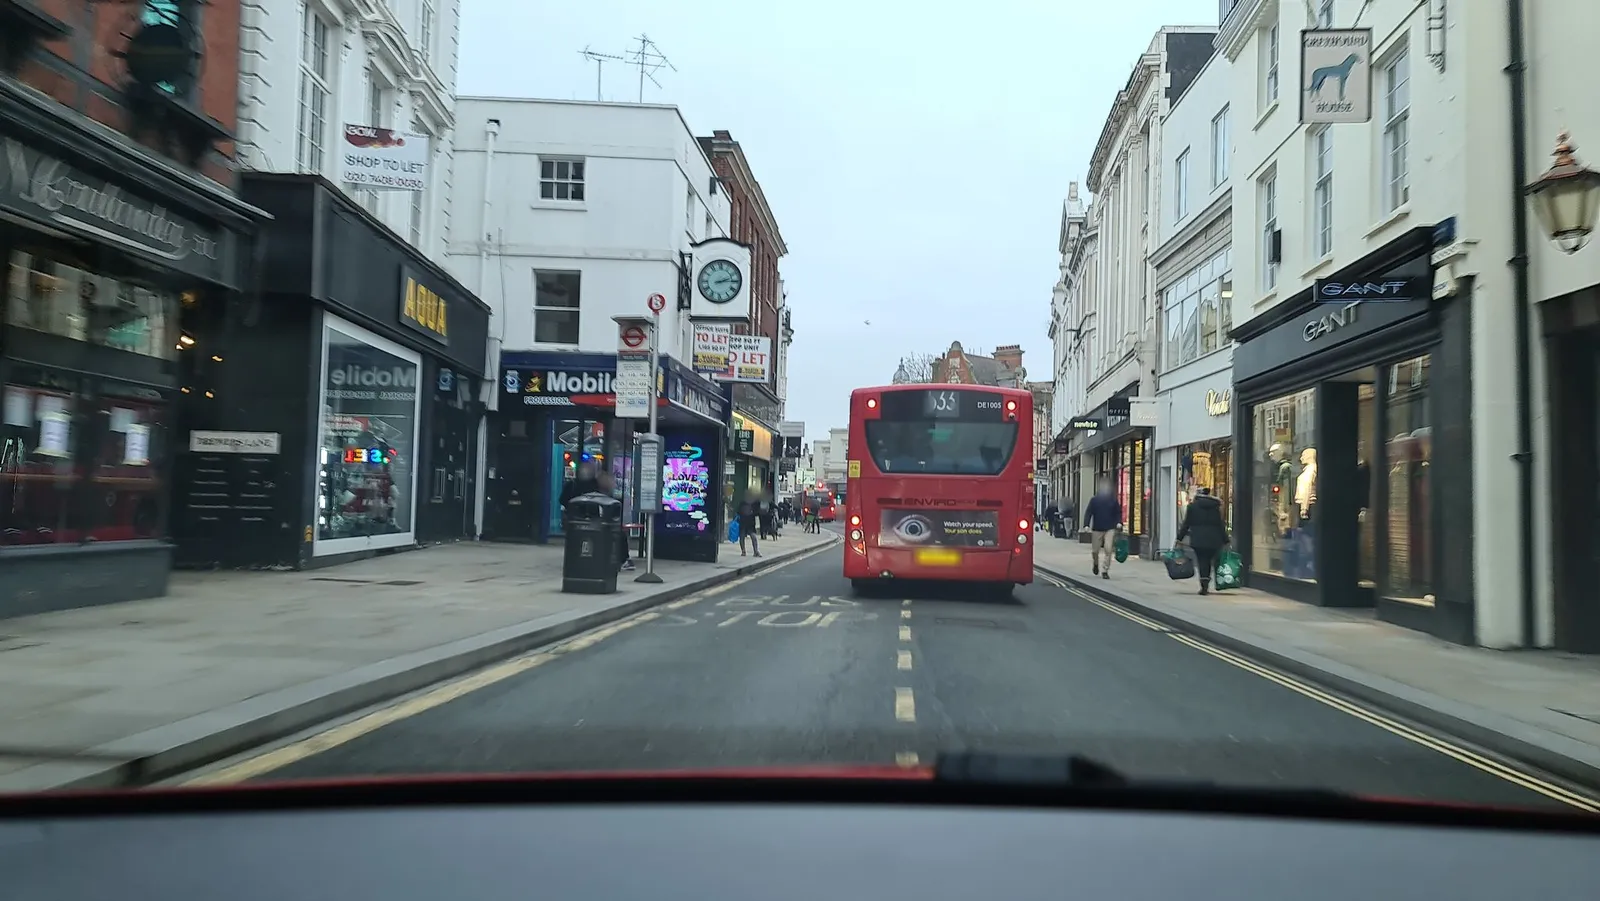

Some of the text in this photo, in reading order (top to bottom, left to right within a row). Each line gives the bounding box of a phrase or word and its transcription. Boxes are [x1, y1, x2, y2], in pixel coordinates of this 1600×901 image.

[1302, 34, 1369, 48] GREYHOUND
[1315, 101, 1355, 114] HOUSE
[344, 153, 425, 174] SHOP TO LET
[1321, 281, 1408, 296] GANT
[1302, 300, 1361, 343] GANT
[696, 332, 709, 343] TO
[711, 333, 729, 345] LET
[743, 344, 760, 353] UNIT
[742, 352, 767, 365] LET
[977, 401, 1002, 410] DE1005
[1108, 408, 1129, 416] OFFIC
[1073, 420, 1098, 429] newbie
[671, 472, 698, 482] LOVE
[668, 483, 702, 495] POWER
[715, 594, 862, 607] BUS
[650, 610, 879, 628] STOP
